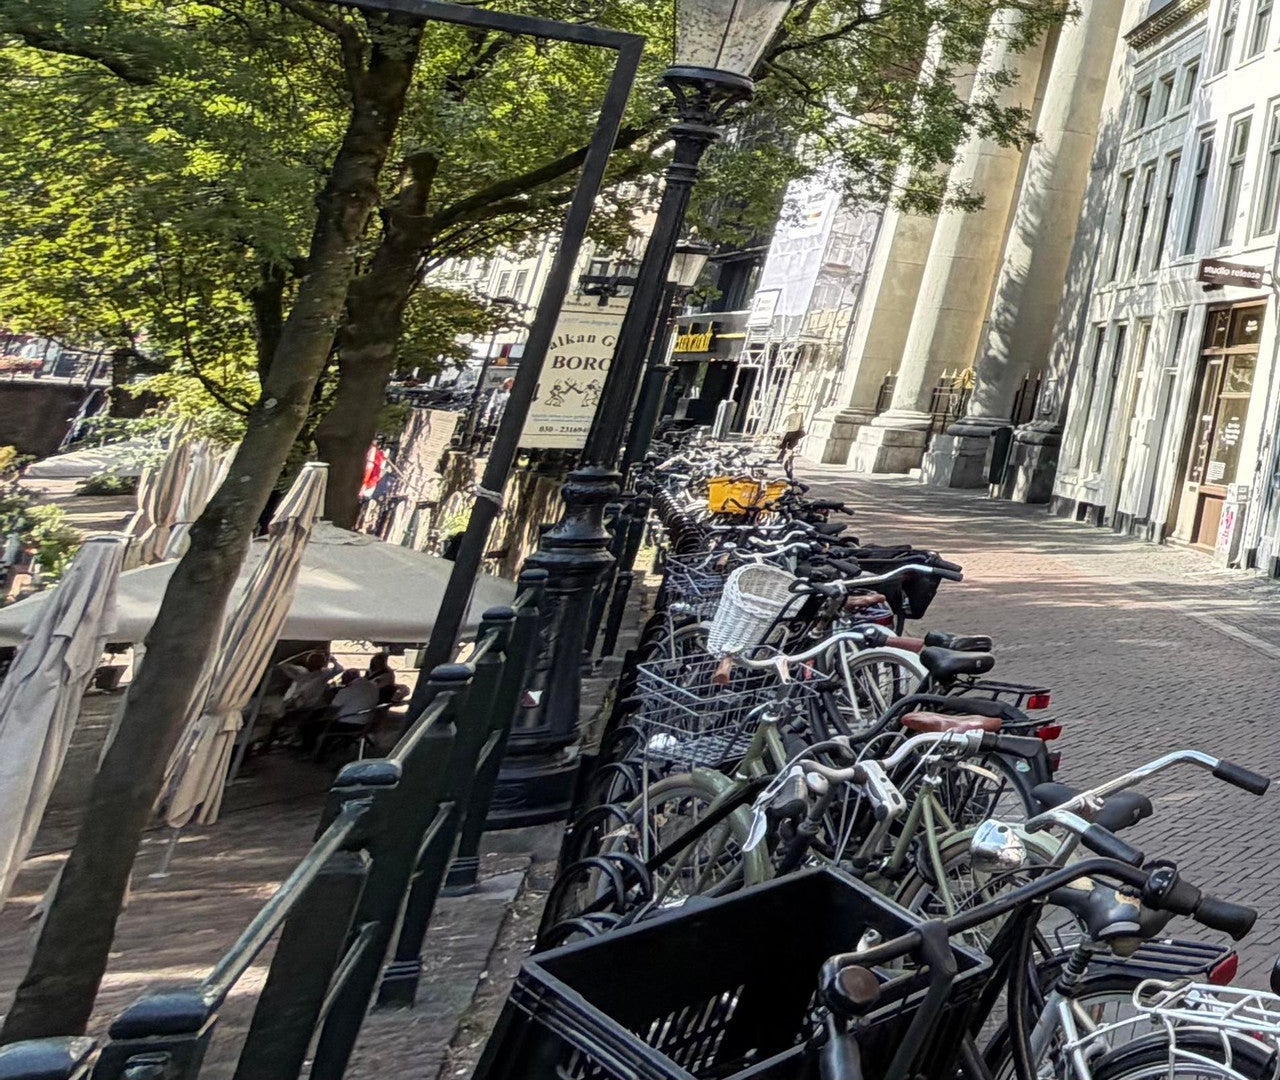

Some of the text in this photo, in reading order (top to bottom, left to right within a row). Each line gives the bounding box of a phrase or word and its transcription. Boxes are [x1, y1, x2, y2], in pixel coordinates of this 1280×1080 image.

[1204, 266, 1261, 280] studio release
[549, 333, 596, 351] alkan
